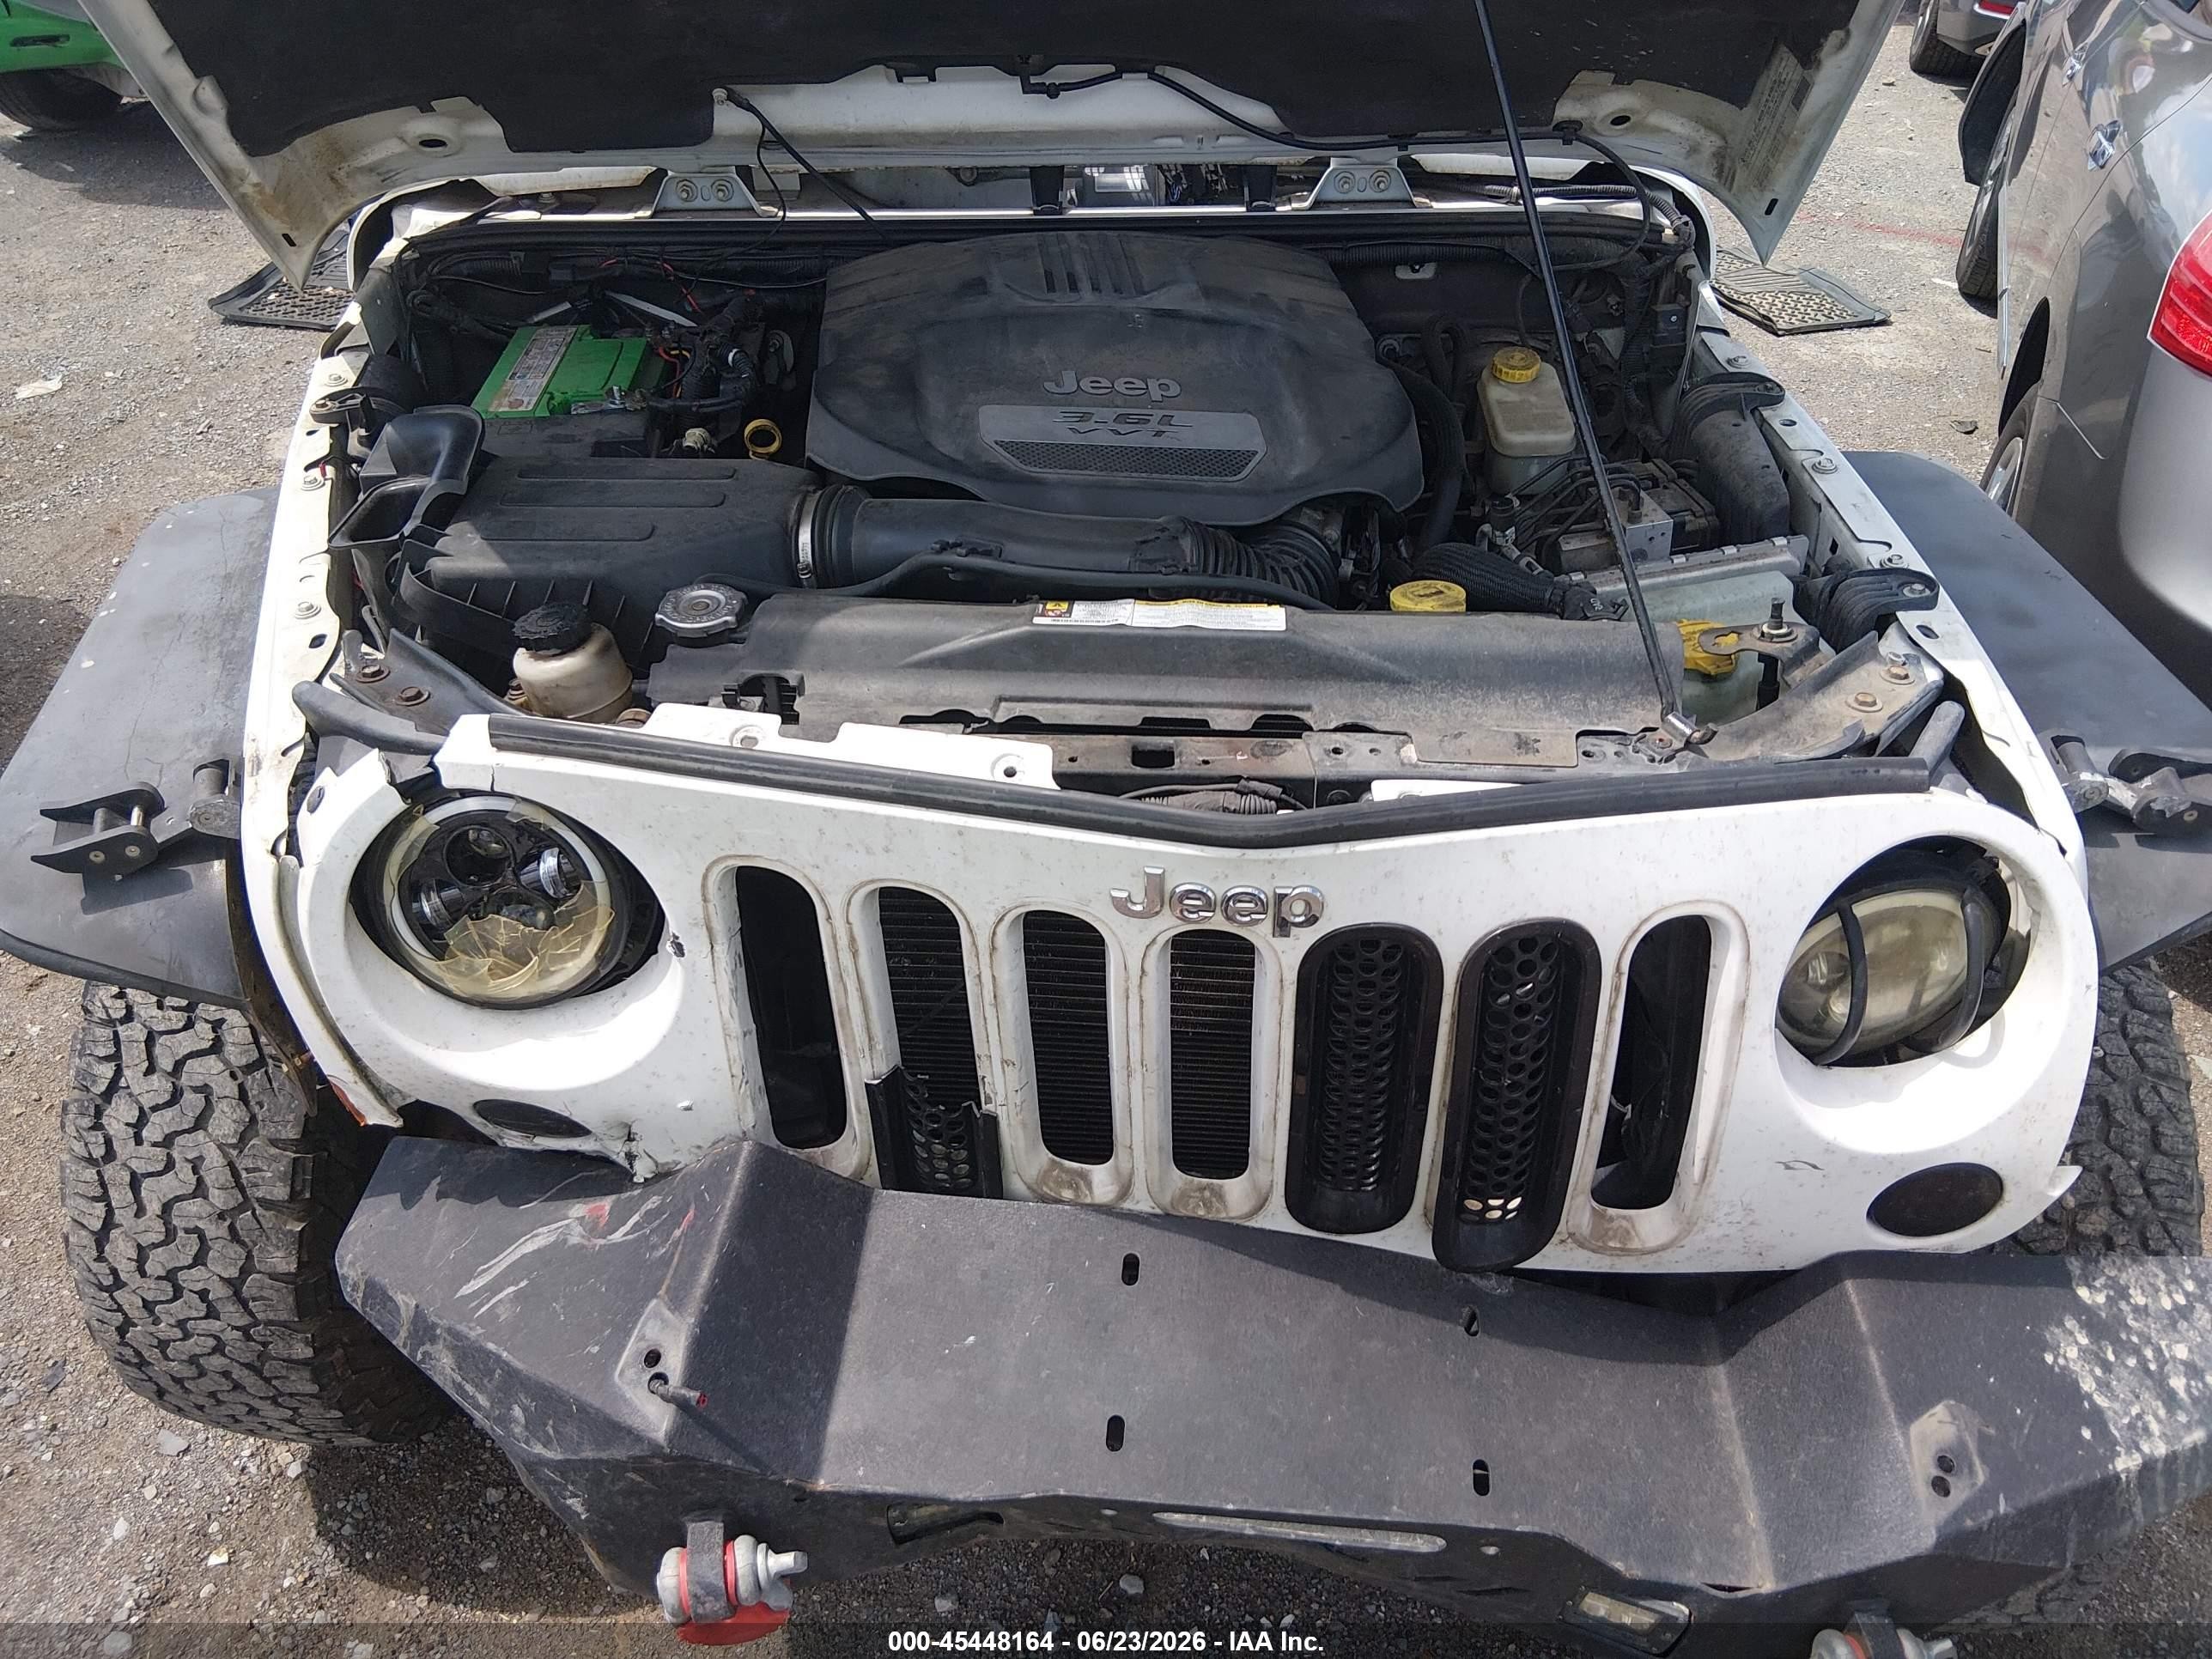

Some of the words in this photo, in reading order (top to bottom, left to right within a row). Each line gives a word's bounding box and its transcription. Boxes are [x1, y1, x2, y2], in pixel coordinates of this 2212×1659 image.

[1043, 370, 1182, 403] Jeep
[1053, 410, 1194, 428] 3.6L
[1066, 426, 1180, 438] VVT
[1109, 866, 1325, 939] Jeep
